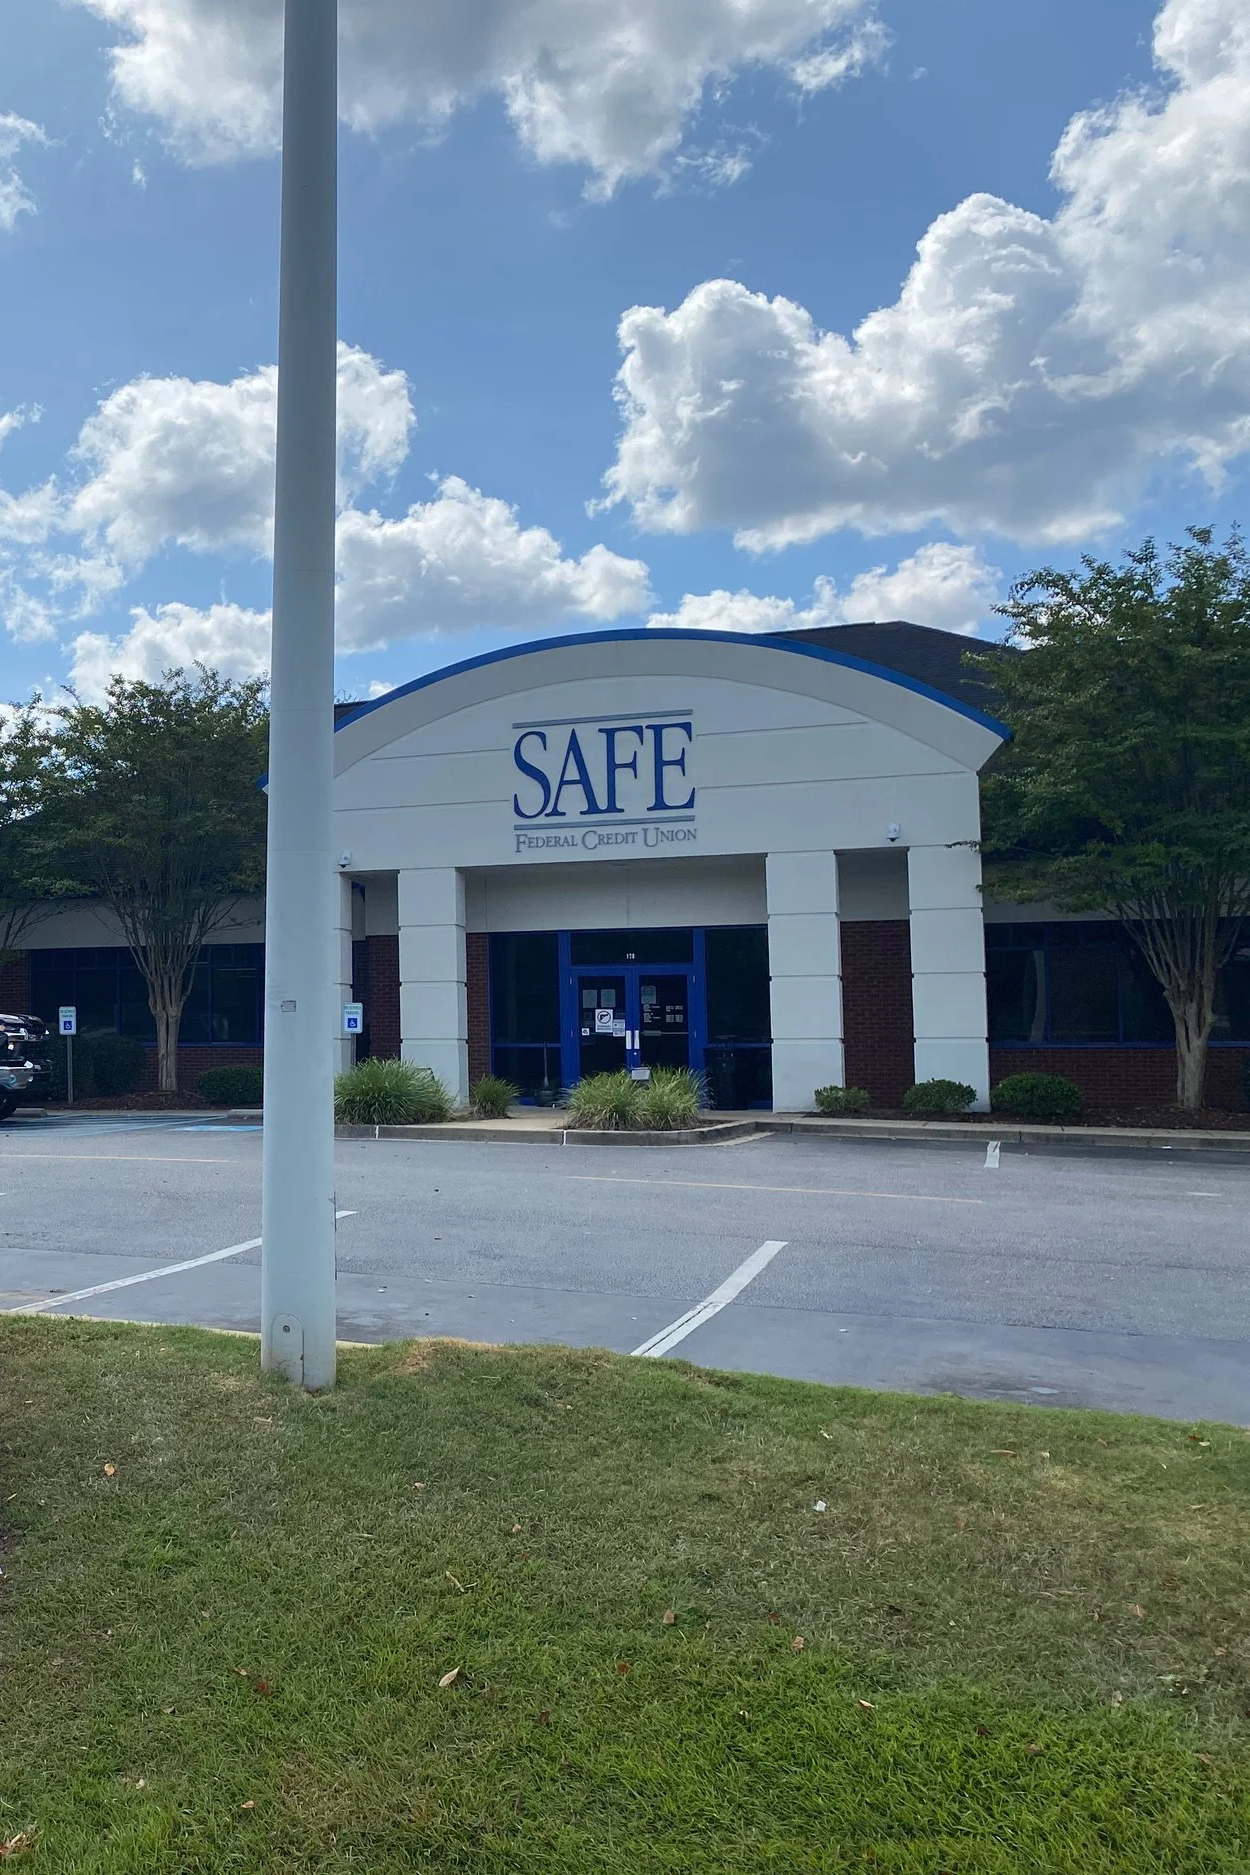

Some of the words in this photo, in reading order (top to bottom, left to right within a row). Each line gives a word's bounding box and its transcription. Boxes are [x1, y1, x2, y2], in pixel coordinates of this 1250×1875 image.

[514, 722, 695, 819] SAFE
[514, 833, 578, 853] FEDERAL
[581, 830, 638, 850] CREDIT
[642, 828, 697, 848] UNION
